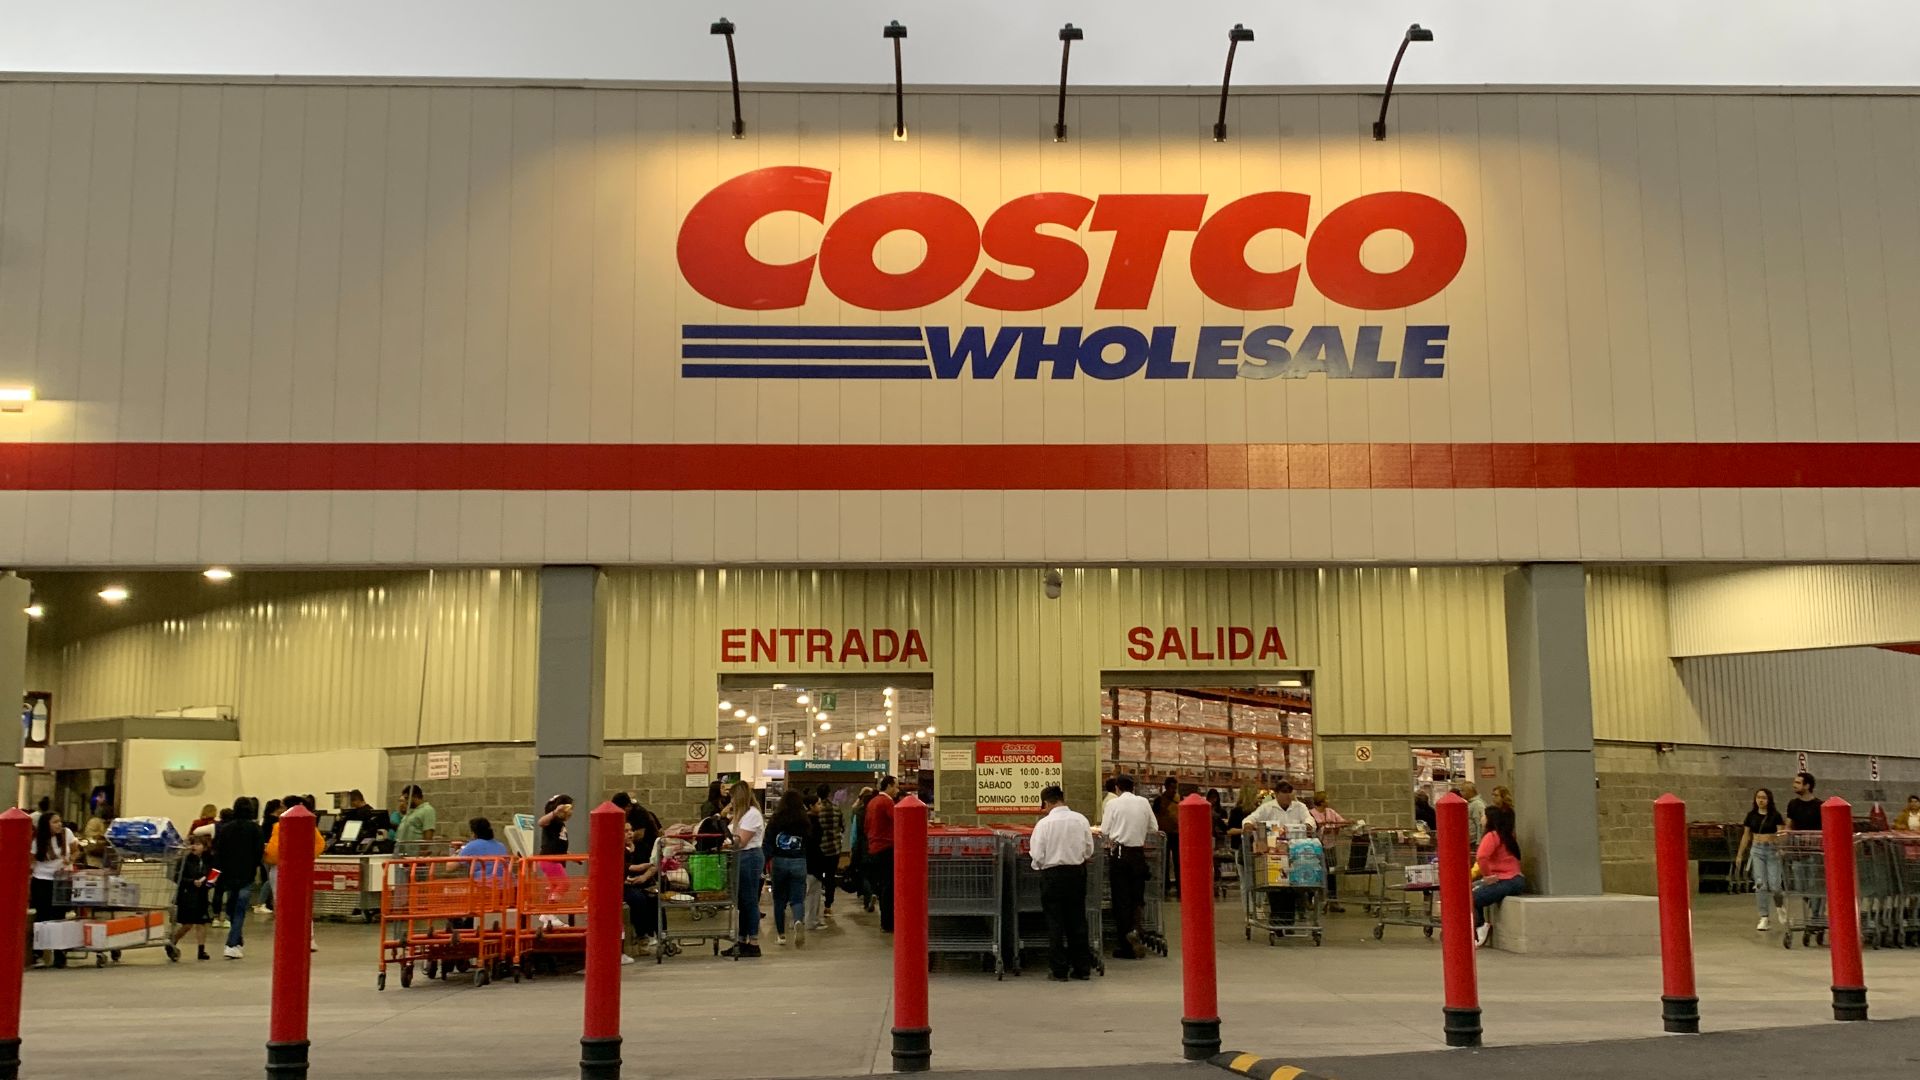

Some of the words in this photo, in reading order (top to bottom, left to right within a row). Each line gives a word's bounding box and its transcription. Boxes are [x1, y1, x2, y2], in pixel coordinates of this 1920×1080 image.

[677, 165, 1467, 312] COSTCO
[925, 325, 1450, 379] WHOLESALE
[721, 628, 928, 663] ENTRADA
[1128, 627, 1286, 661] SALIDA
[984, 755, 1025, 763] EXCLUSIVO
[1026, 755, 1054, 763] SOCIOS
[978, 768, 994, 776] LUN
[1000, 768, 1013, 776] VIE
[1020, 768, 1039, 776] 10:00
[1045, 768, 1060, 776] 8:30
[978, 780, 1012, 789] SÁBADO
[1023, 781, 1039, 789] 9:30
[978, 795, 1016, 803] DOMINGO
[1020, 795, 1040, 803] 10:00
